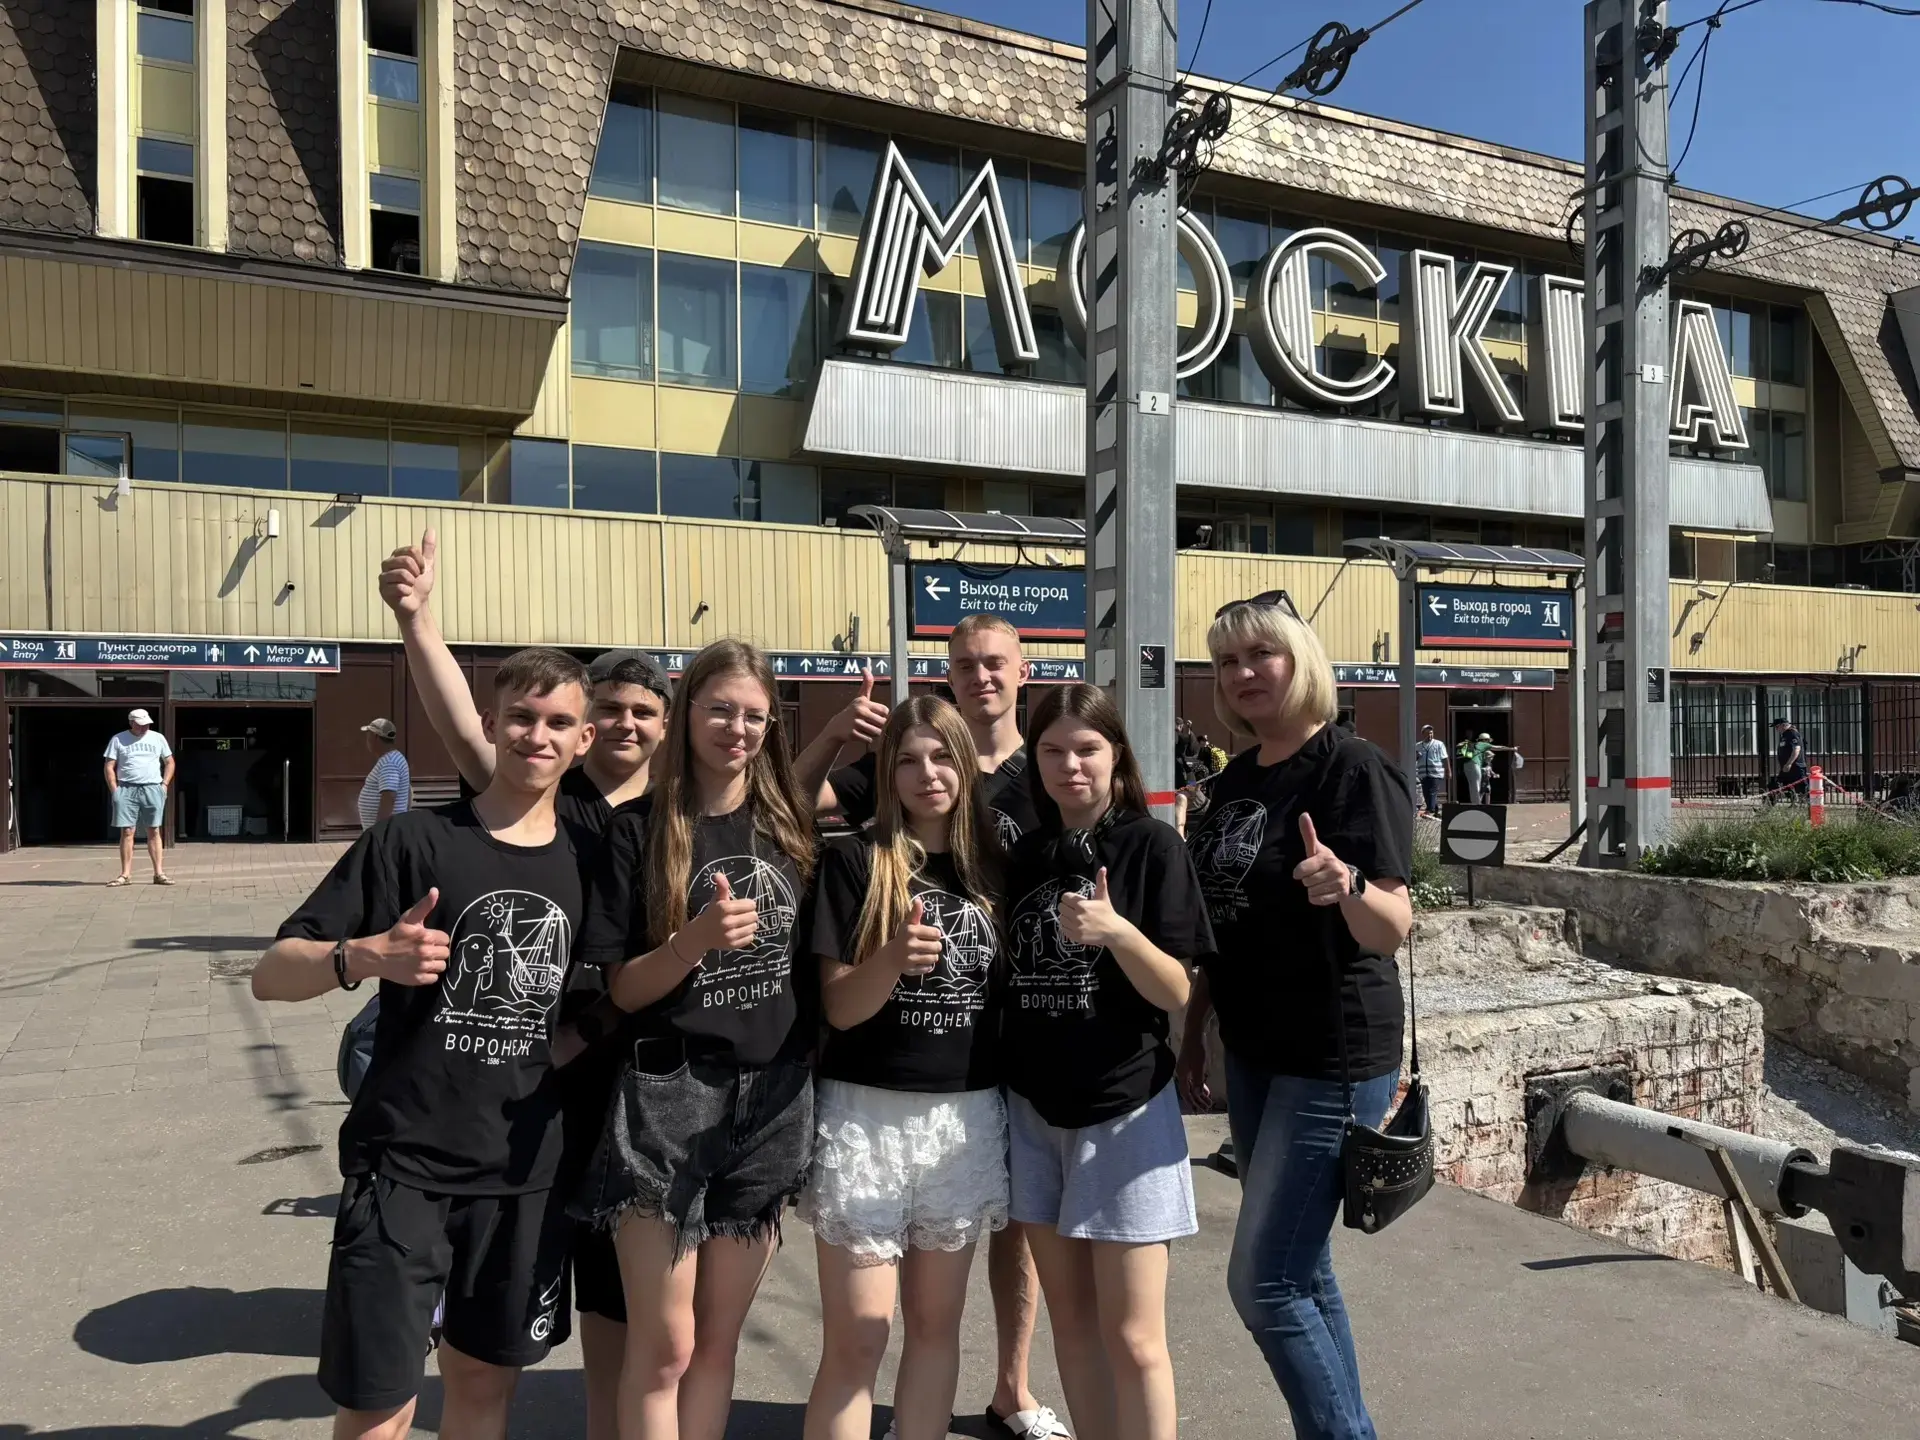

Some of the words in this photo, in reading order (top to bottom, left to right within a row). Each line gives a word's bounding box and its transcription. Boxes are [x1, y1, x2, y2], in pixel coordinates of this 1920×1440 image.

[1151, 395, 1157, 412] 2
[959, 580, 1009, 599] Выход
[1012, 586, 1021, 597] в
[1024, 586, 1069, 602] город
[960, 598, 981, 610] Exit
[984, 600, 996, 611] to
[999, 599, 1017, 611] the
[1019, 600, 1039, 615] city
[1453, 598, 1489, 614] Выход
[1490, 602, 1497, 612] в
[1499, 602, 1532, 616] город
[1454, 613, 1469, 624] Exit
[1471, 614, 1480, 624] to
[1481, 614, 1495, 624] the
[1496, 614, 1511, 627] city
[12, 640, 45, 652] Вход
[98, 641, 136, 653] Пункт
[138, 644, 198, 655] досмотра
[266, 645, 305, 655] Метро
[12, 651, 39, 661] Entry
[98, 652, 146, 662] Inspection
[146, 653, 170, 661] zone
[266, 655, 293, 663] Metro
[816, 658, 844, 668] Метро
[1041, 663, 1065, 672] Метро
[703, 978, 783, 1008] ВОРОНЕЖ
[1021, 993, 1090, 1010] ВОРОНЕЖ
[900, 1009, 972, 1028] ВОРОНЕЖ
[444, 1033, 533, 1057] ВОРОНЕЖ
